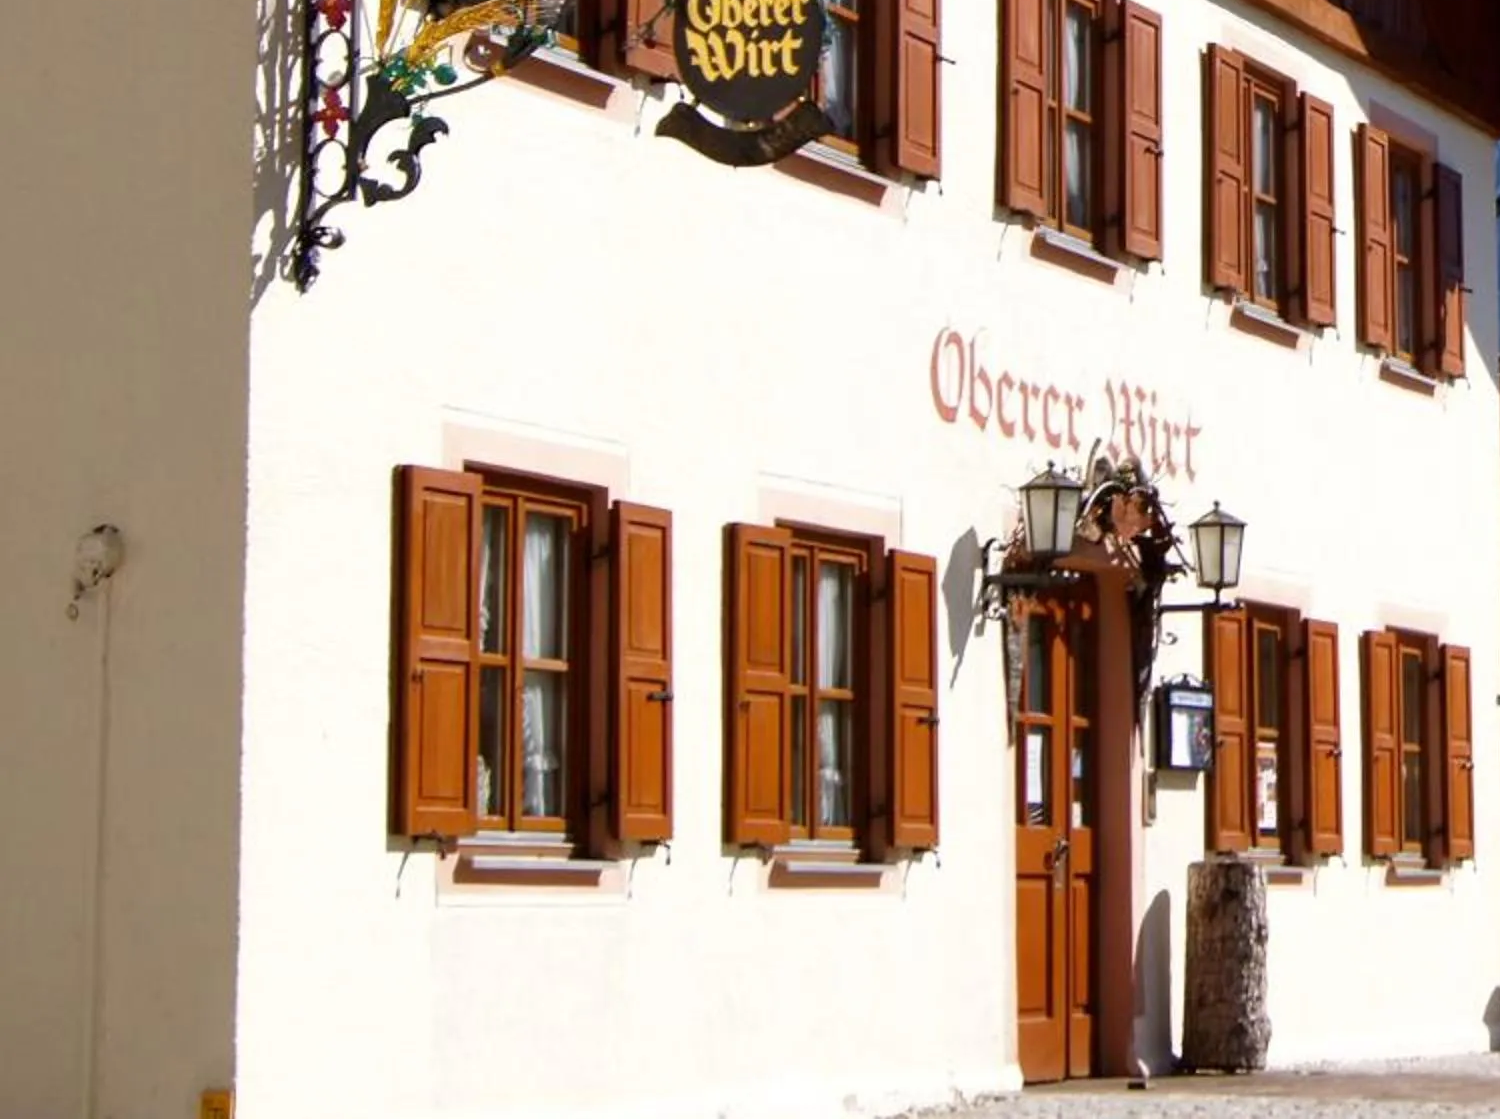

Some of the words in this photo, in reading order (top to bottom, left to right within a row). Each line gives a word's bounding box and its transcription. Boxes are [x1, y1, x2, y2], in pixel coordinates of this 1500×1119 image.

[685, 28, 803, 82] Wirt
[930, 325, 1085, 453] Oberer
[1104, 377, 1202, 483] Wirt
